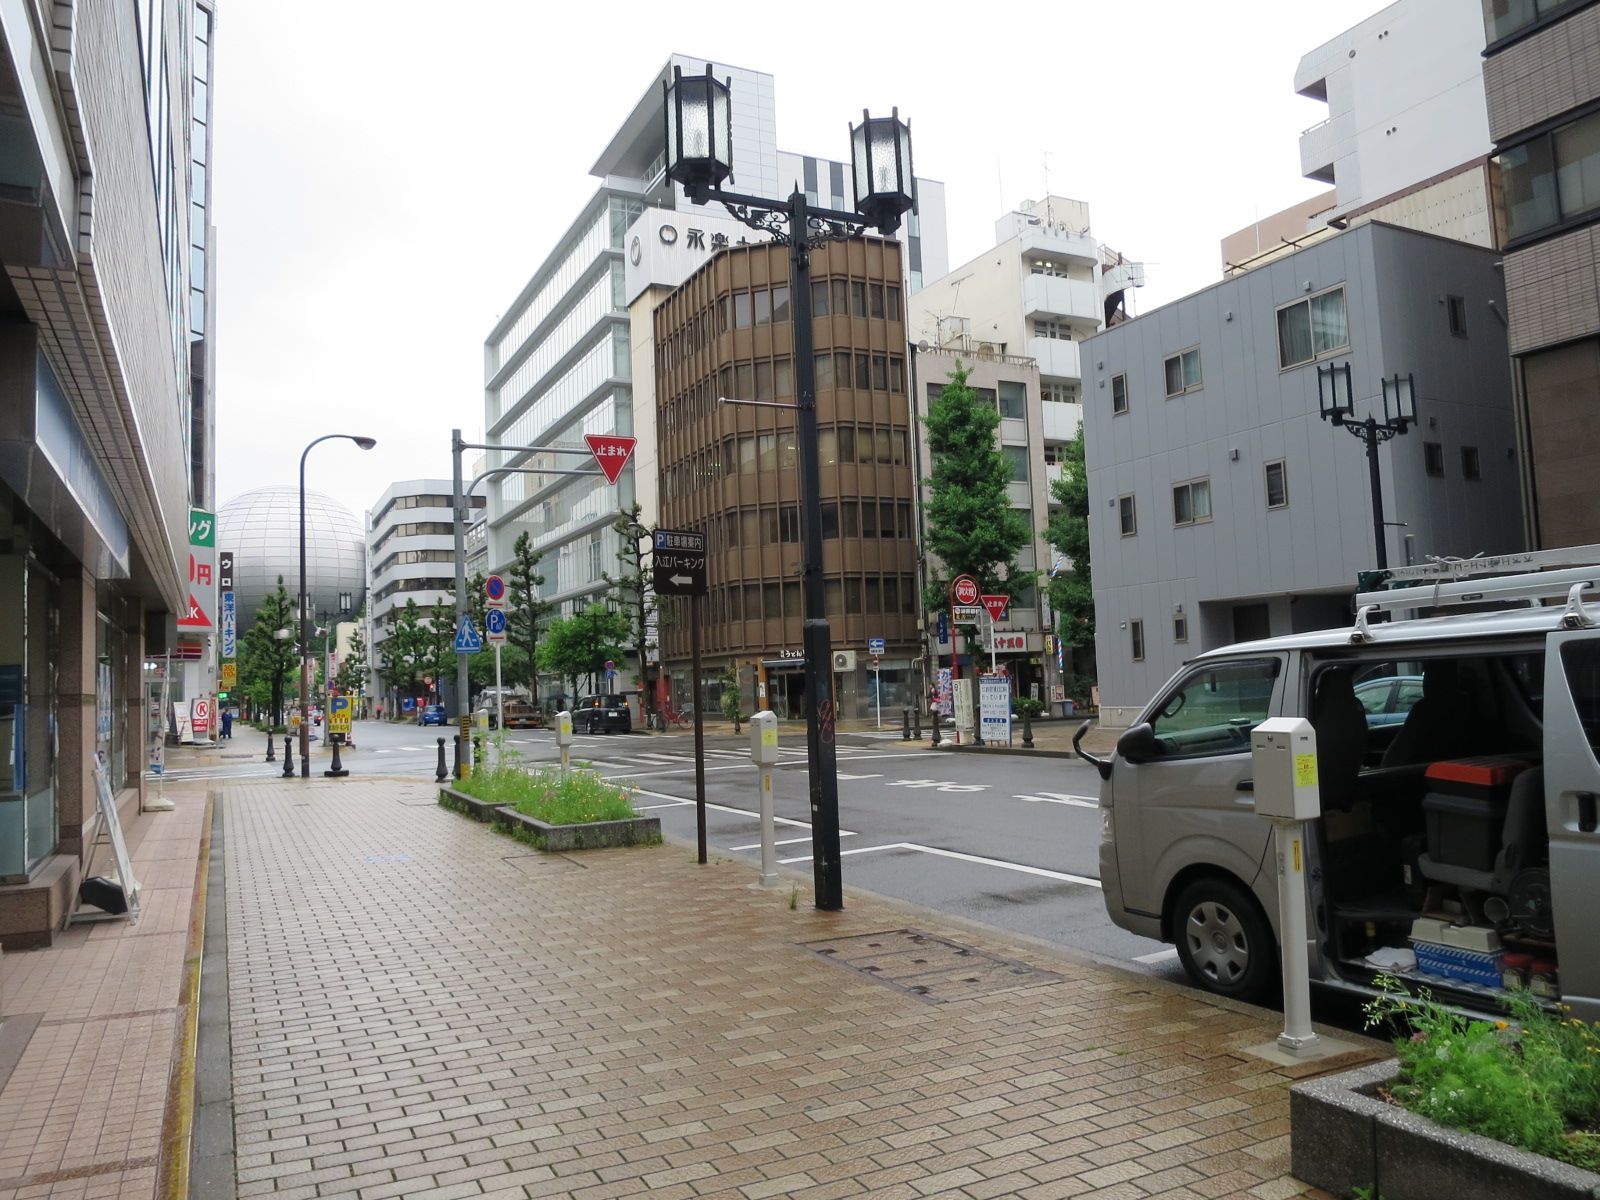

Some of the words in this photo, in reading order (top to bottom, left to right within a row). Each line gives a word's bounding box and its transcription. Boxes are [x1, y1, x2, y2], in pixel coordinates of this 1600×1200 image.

[596, 446, 628, 457] 止まれ
[656, 534, 665, 546] P
[666, 535, 702, 549] 駐車場案内
[655, 555, 705, 570] 入江パーキング
[223, 592, 235, 657] 東洋パーキング
[490, 614, 499, 630] P
[941, 670, 950, 692] カット
[331, 697, 348, 714] P
